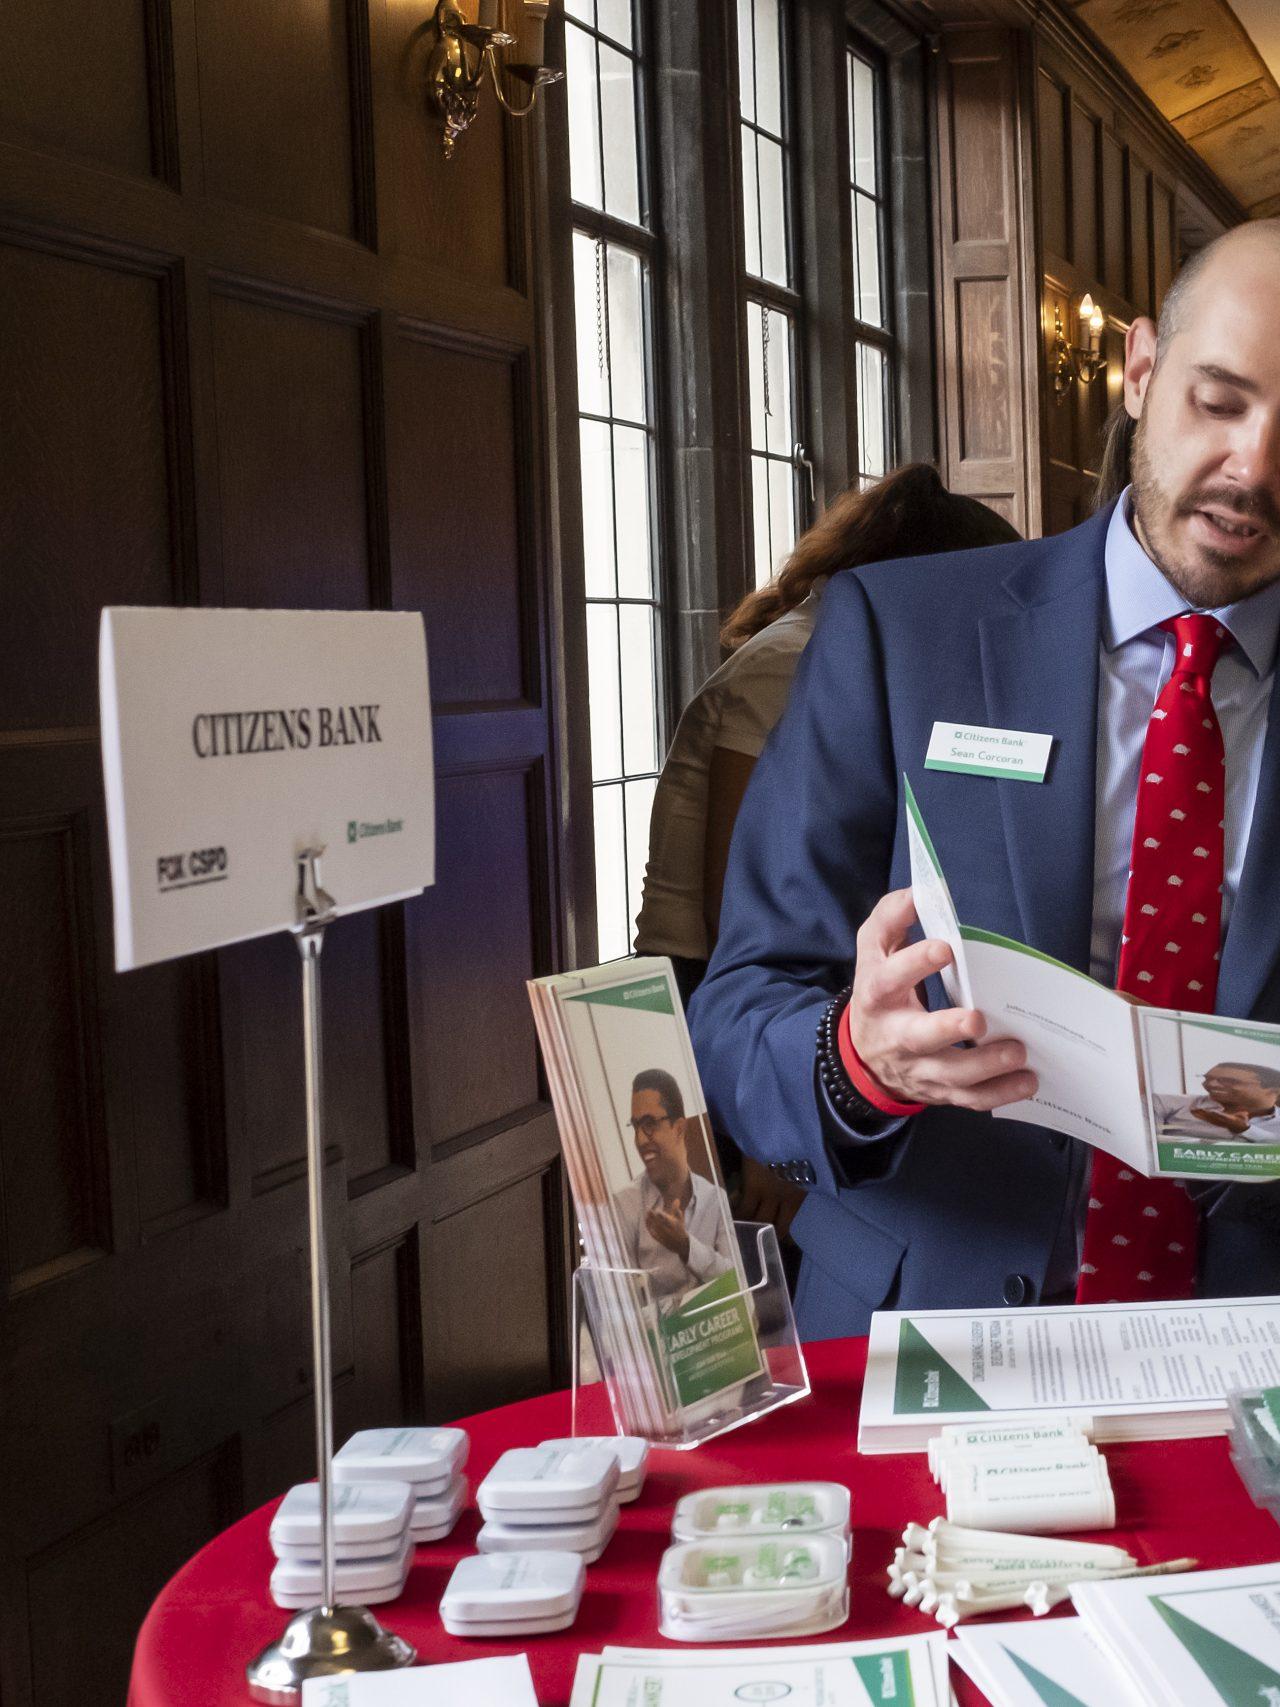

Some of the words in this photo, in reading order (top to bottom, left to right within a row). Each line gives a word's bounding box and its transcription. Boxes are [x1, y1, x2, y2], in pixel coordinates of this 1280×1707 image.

[193, 708, 312, 758] CITIZENS
[318, 705, 382, 747] BANK
[964, 732, 1000, 744] Citizens
[1001, 737, 1024, 747] Bank
[951, 747, 975, 759] Sean
[978, 751, 1024, 765] Corcoran
[158, 854, 186, 882] FOX
[1173, 1148, 1225, 1158] EARLY
[668, 1325, 698, 1352] ARLY
[700, 1307, 741, 1337] CAREER
[980, 1432, 1030, 1443] Citizens
[1033, 1428, 1064, 1440] Bank
